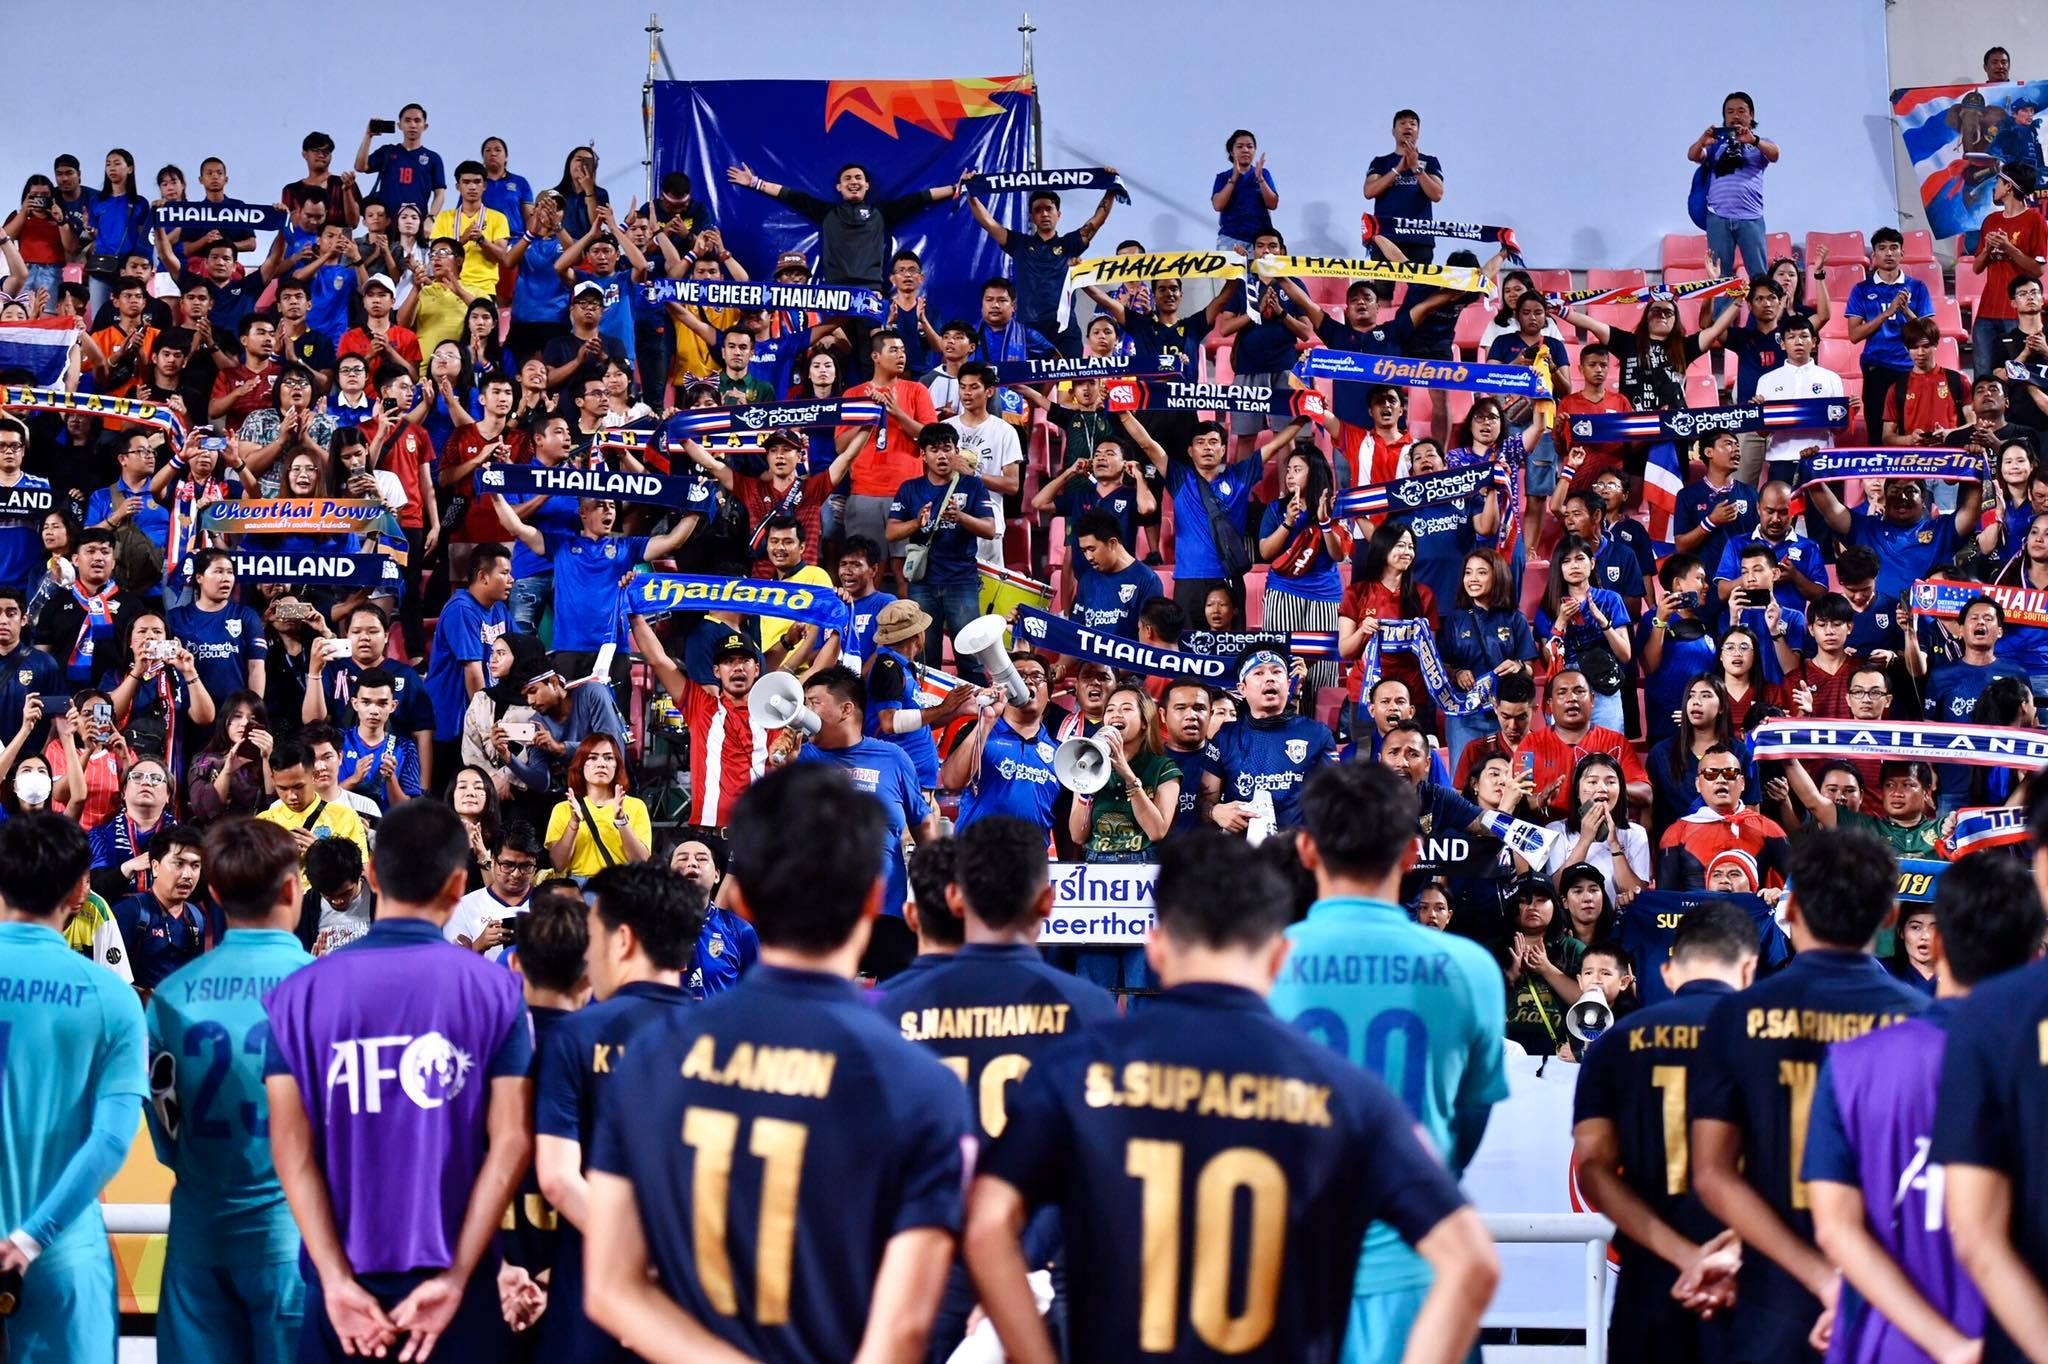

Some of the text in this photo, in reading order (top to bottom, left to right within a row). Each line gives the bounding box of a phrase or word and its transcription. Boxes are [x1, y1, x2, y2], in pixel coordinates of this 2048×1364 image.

[985, 171, 1094, 189] THAILAND
[156, 206, 265, 224] THAILAND
[1393, 217, 1483, 233] THAILAND
[1395, 227, 1482, 239] NATIONAL TEAM
[1093, 254, 1226, 281] THAILAND
[1290, 256, 1443, 276] THAILAND
[1311, 269, 1350, 277] NATIONAL
[1352, 270, 1391, 279] FOOTBALL
[675, 281, 851, 311] WE CHEER THAILAND
[1026, 356, 1130, 374] THAILAND
[1048, 368, 1108, 379] NATIONAL FOOTBALL
[1372, 358, 1469, 383] thailand
[1166, 382, 1273, 401] THAILAND
[768, 403, 838, 415] cheerthai
[1167, 397, 1271, 413] NATIONAL TEAM
[768, 411, 820, 427] power
[1695, 406, 1759, 423] cheerthai
[1424, 465, 1491, 491] cheerthai
[1885, 465, 1938, 473] THAILAND
[530, 470, 662, 496] THAILAND
[1427, 481, 1476, 502] power
[213, 501, 384, 521] Cheerthai Power
[1426, 513, 1468, 527] cheerthai
[1427, 522, 1459, 535] power
[643, 578, 814, 610] thailand
[1094, 608, 1129, 619] cheerthai
[1094, 616, 1118, 627] power
[2013, 610, 2022, 618] OF
[1216, 631, 1286, 645] cheerthai
[198, 641, 240, 654] cheerthai
[198, 650, 231, 661] power
[1076, 628, 1225, 677] THAILAND
[1773, 730, 2048, 757] THAILAND
[1015, 770, 1048, 785] power
[1254, 770, 1305, 784] cheerthai
[1254, 781, 1293, 791] power
[900, 1003, 1071, 1041] S.NANTHAWAT
[1628, 1025, 1706, 1051] K.KRI
[681, 1034, 837, 1099] A.ANON
[1084, 1060, 1332, 1128] S.SUPACHOK
[681, 1106, 808, 1326] 11
[1125, 1138, 1289, 1354] 10
